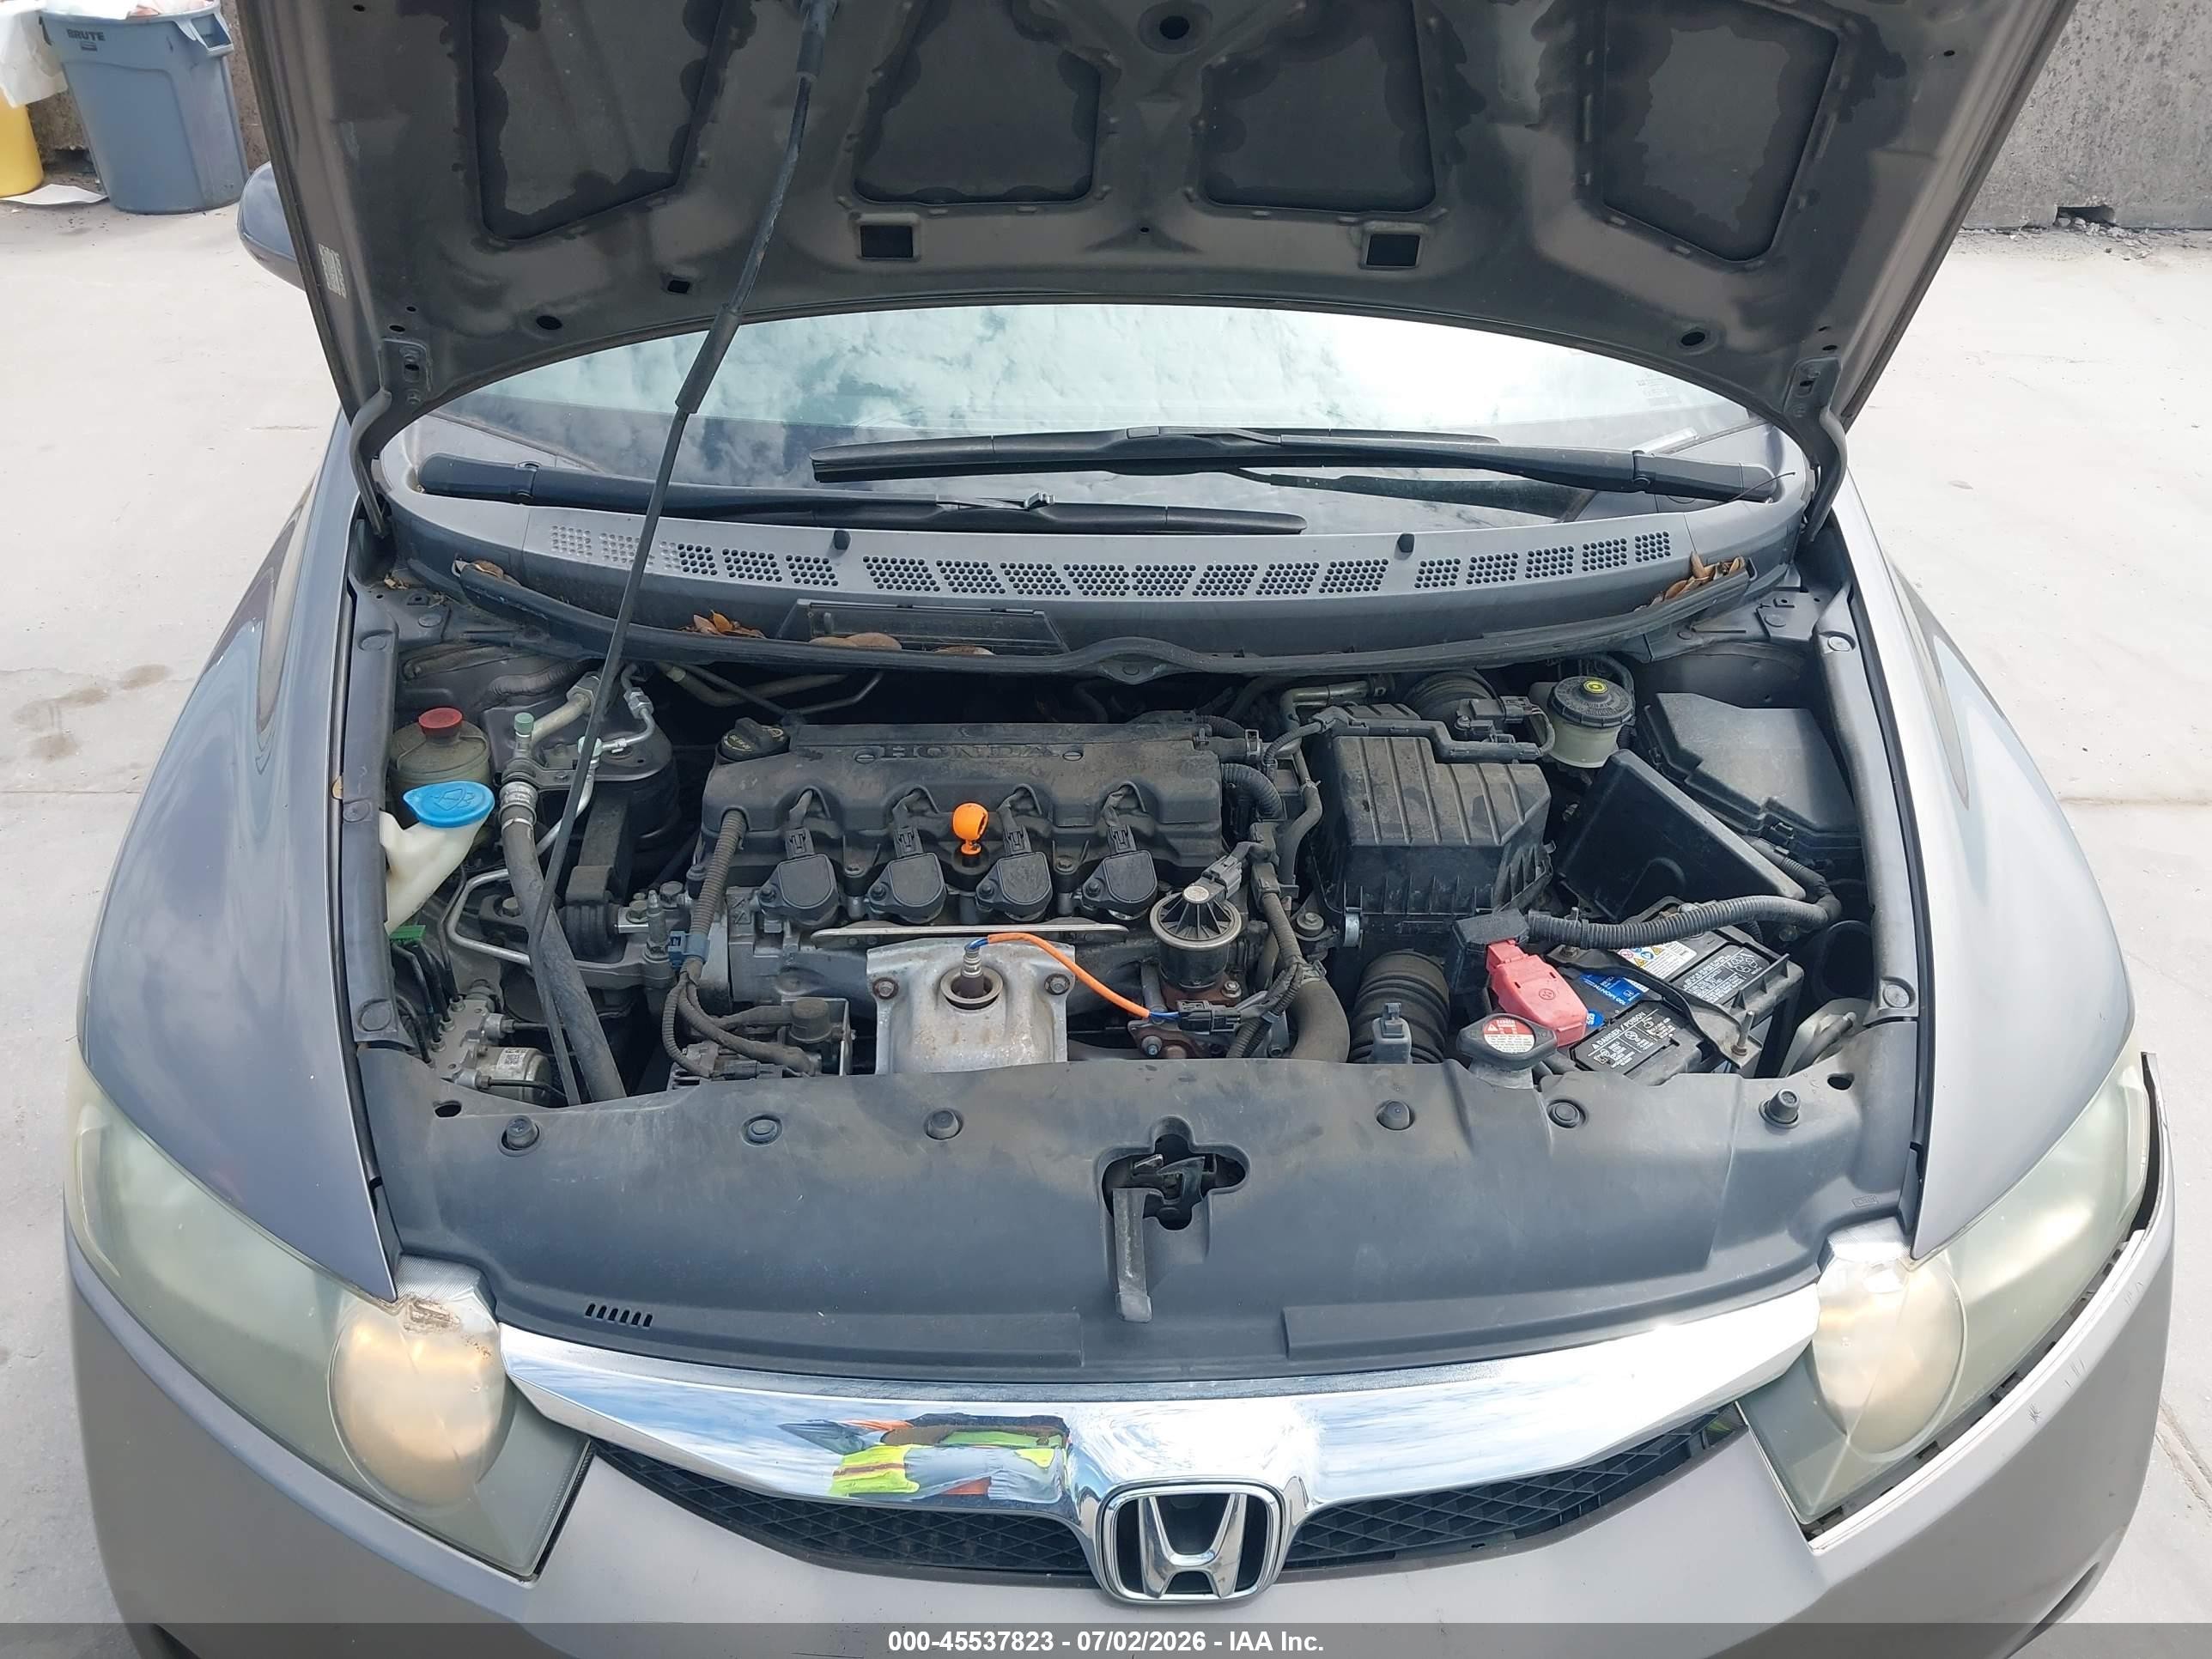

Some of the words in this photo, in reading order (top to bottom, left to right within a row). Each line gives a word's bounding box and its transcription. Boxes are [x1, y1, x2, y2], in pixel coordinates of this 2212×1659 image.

[882, 744, 1060, 759] HONDA
[1596, 1028, 1622, 1046] DANGER
[1623, 1012, 1647, 1028] POISON
